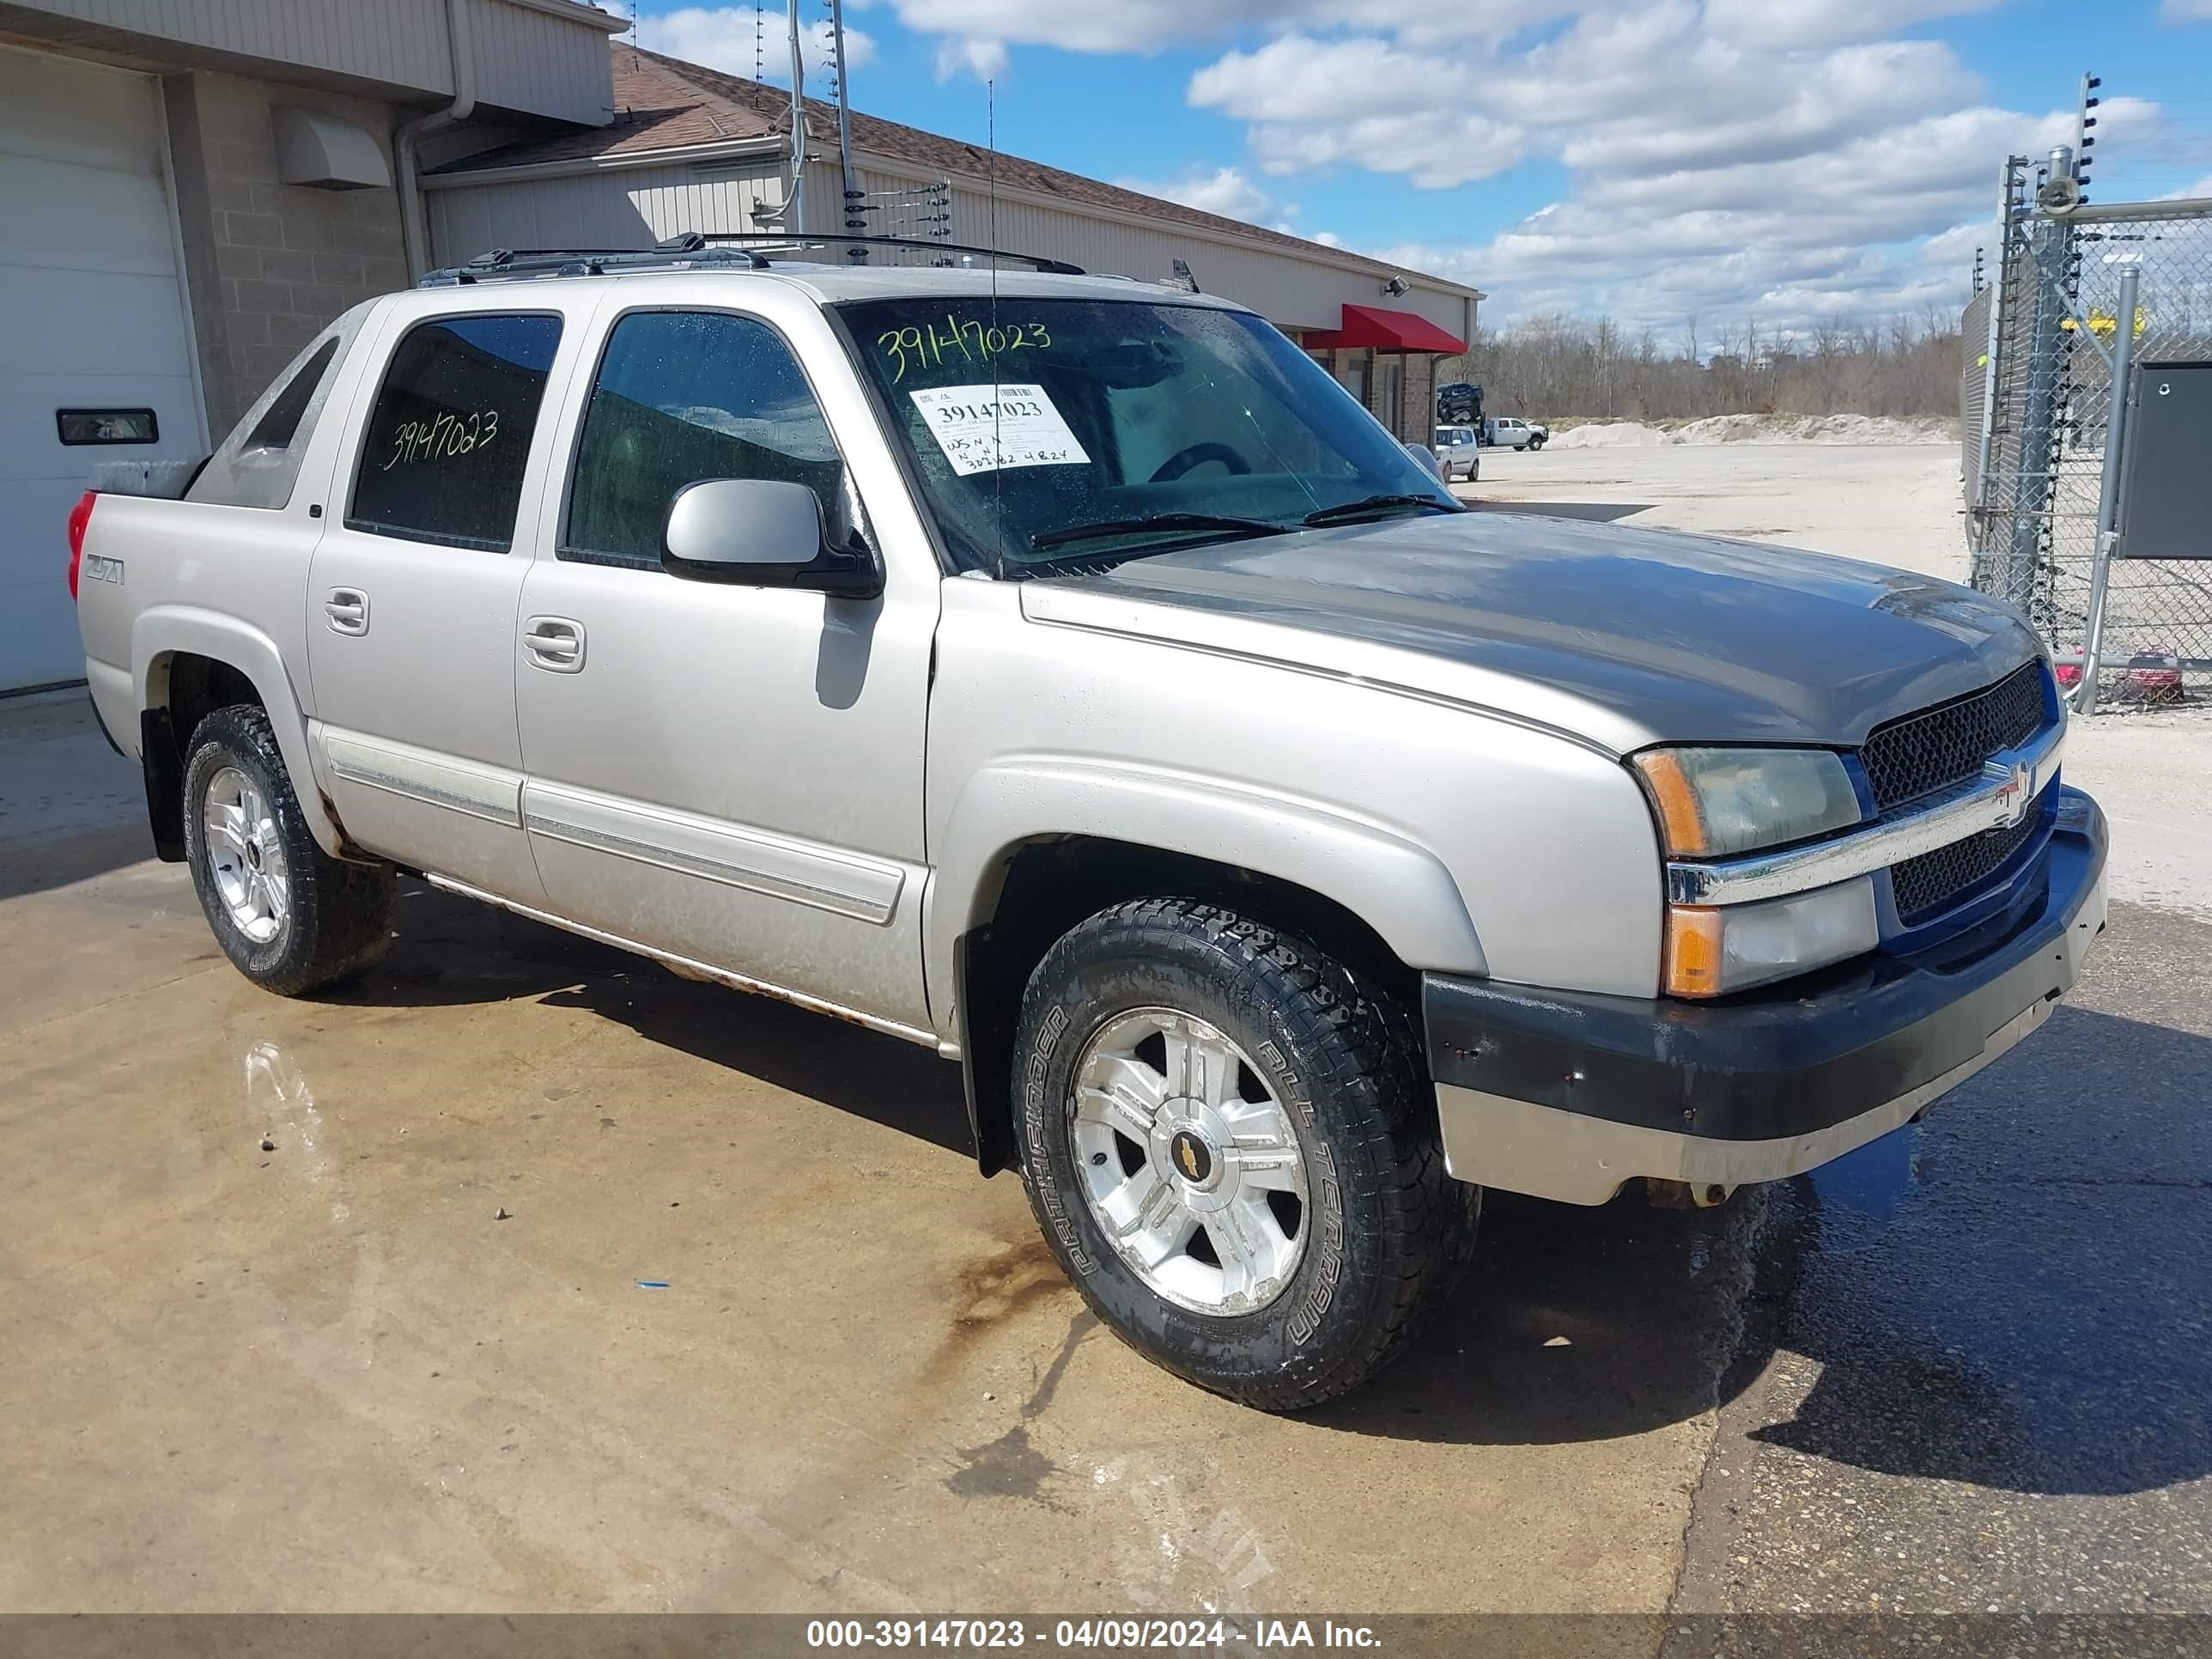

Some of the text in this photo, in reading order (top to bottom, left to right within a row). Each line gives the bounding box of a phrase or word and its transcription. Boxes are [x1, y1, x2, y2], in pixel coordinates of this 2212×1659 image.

[878, 314, 1051, 385] 39147023
[383, 411, 499, 471] 39147023
[938, 402, 1042, 422] 39147023
[86, 553, 125, 586] Z71
[1025, 1005, 1098, 1278] PATHFINDER
[1257, 1040, 1346, 1346] ALL TERRAIN
